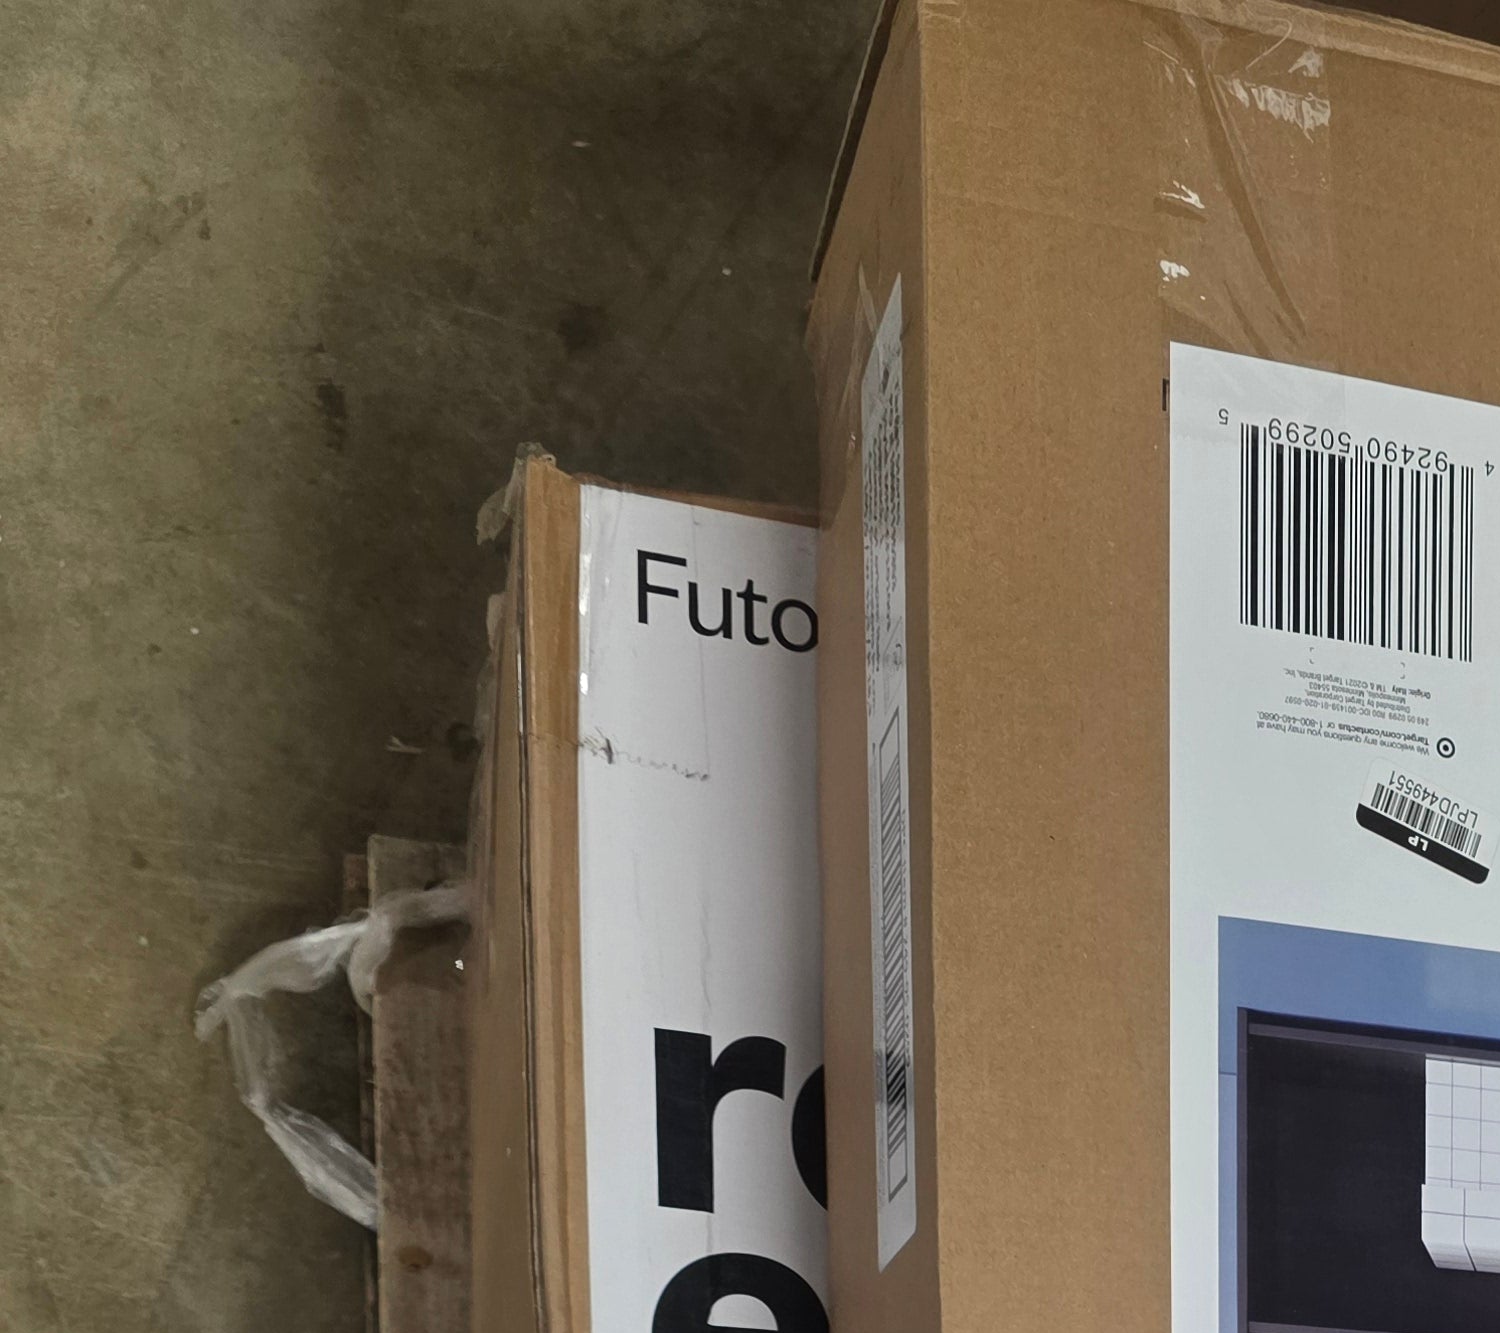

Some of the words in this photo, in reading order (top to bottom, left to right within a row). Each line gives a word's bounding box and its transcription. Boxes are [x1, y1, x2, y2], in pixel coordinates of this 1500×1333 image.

[1214, 406, 1231, 426] 5
[1264, 415, 1353, 454] 50299
[1362, 435, 1451, 473] 92490
[1481, 458, 1496, 478] 4
[633, 547, 819, 653] Futo
[1322, 673, 1343, 686] Target
[1391, 684, 1407, 695] Italy
[1344, 695, 1365, 707] Target
[1366, 698, 1375, 708] by
[1266, 721, 1287, 733] have
[1287, 723, 1305, 735] may
[1326, 721, 1335, 729] or
[1306, 727, 1322, 737] you
[1323, 731, 1362, 743] questions
[1363, 735, 1378, 746] any
[1379, 739, 1415, 751] welcome
[1389, 771, 1478, 828] LPJD449551
[1407, 835, 1429, 851] LP
